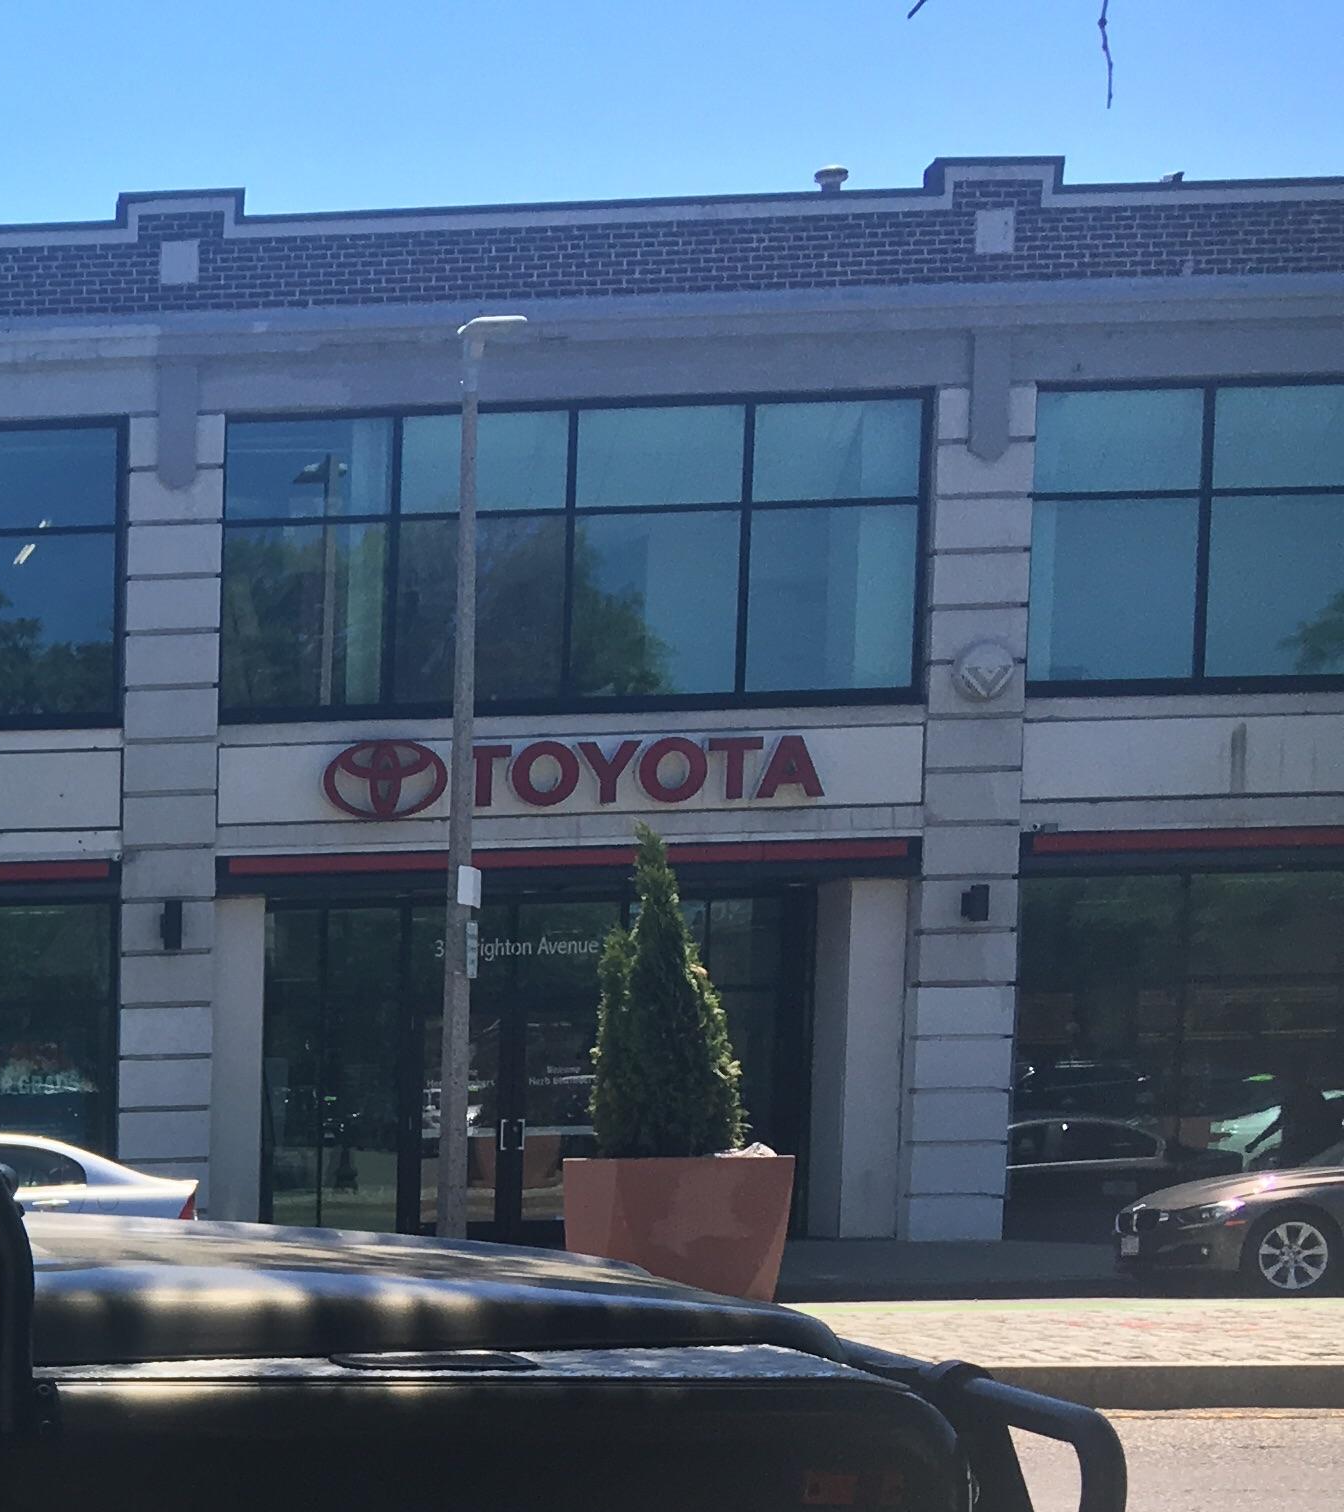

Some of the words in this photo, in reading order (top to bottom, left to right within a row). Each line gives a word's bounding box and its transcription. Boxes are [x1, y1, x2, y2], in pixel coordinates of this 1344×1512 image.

[472, 735, 825, 807] TOYOTA
[477, 938, 532, 961] ighton
[537, 936, 599, 955] Avenue
